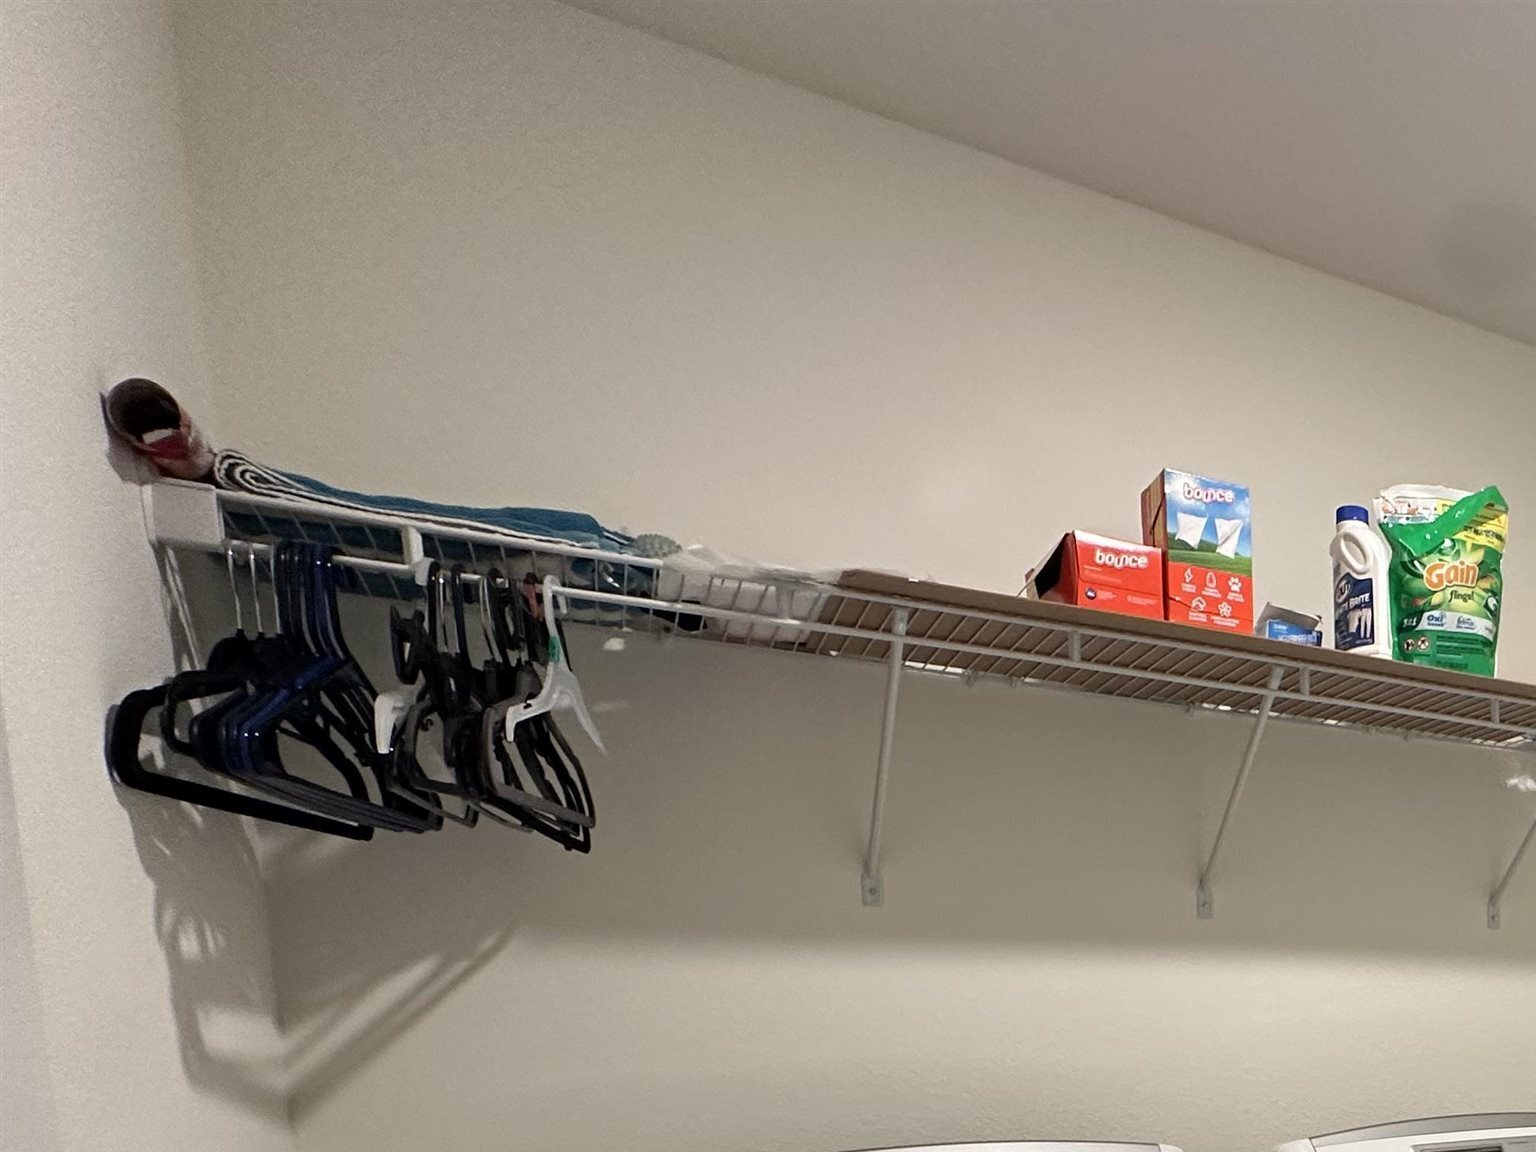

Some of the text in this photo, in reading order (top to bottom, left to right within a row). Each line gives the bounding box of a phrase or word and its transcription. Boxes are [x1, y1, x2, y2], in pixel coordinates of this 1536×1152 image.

[1183, 483, 1235, 503] bounce
[1095, 549, 1148, 569] bounce
[1424, 561, 1479, 591] Gain
